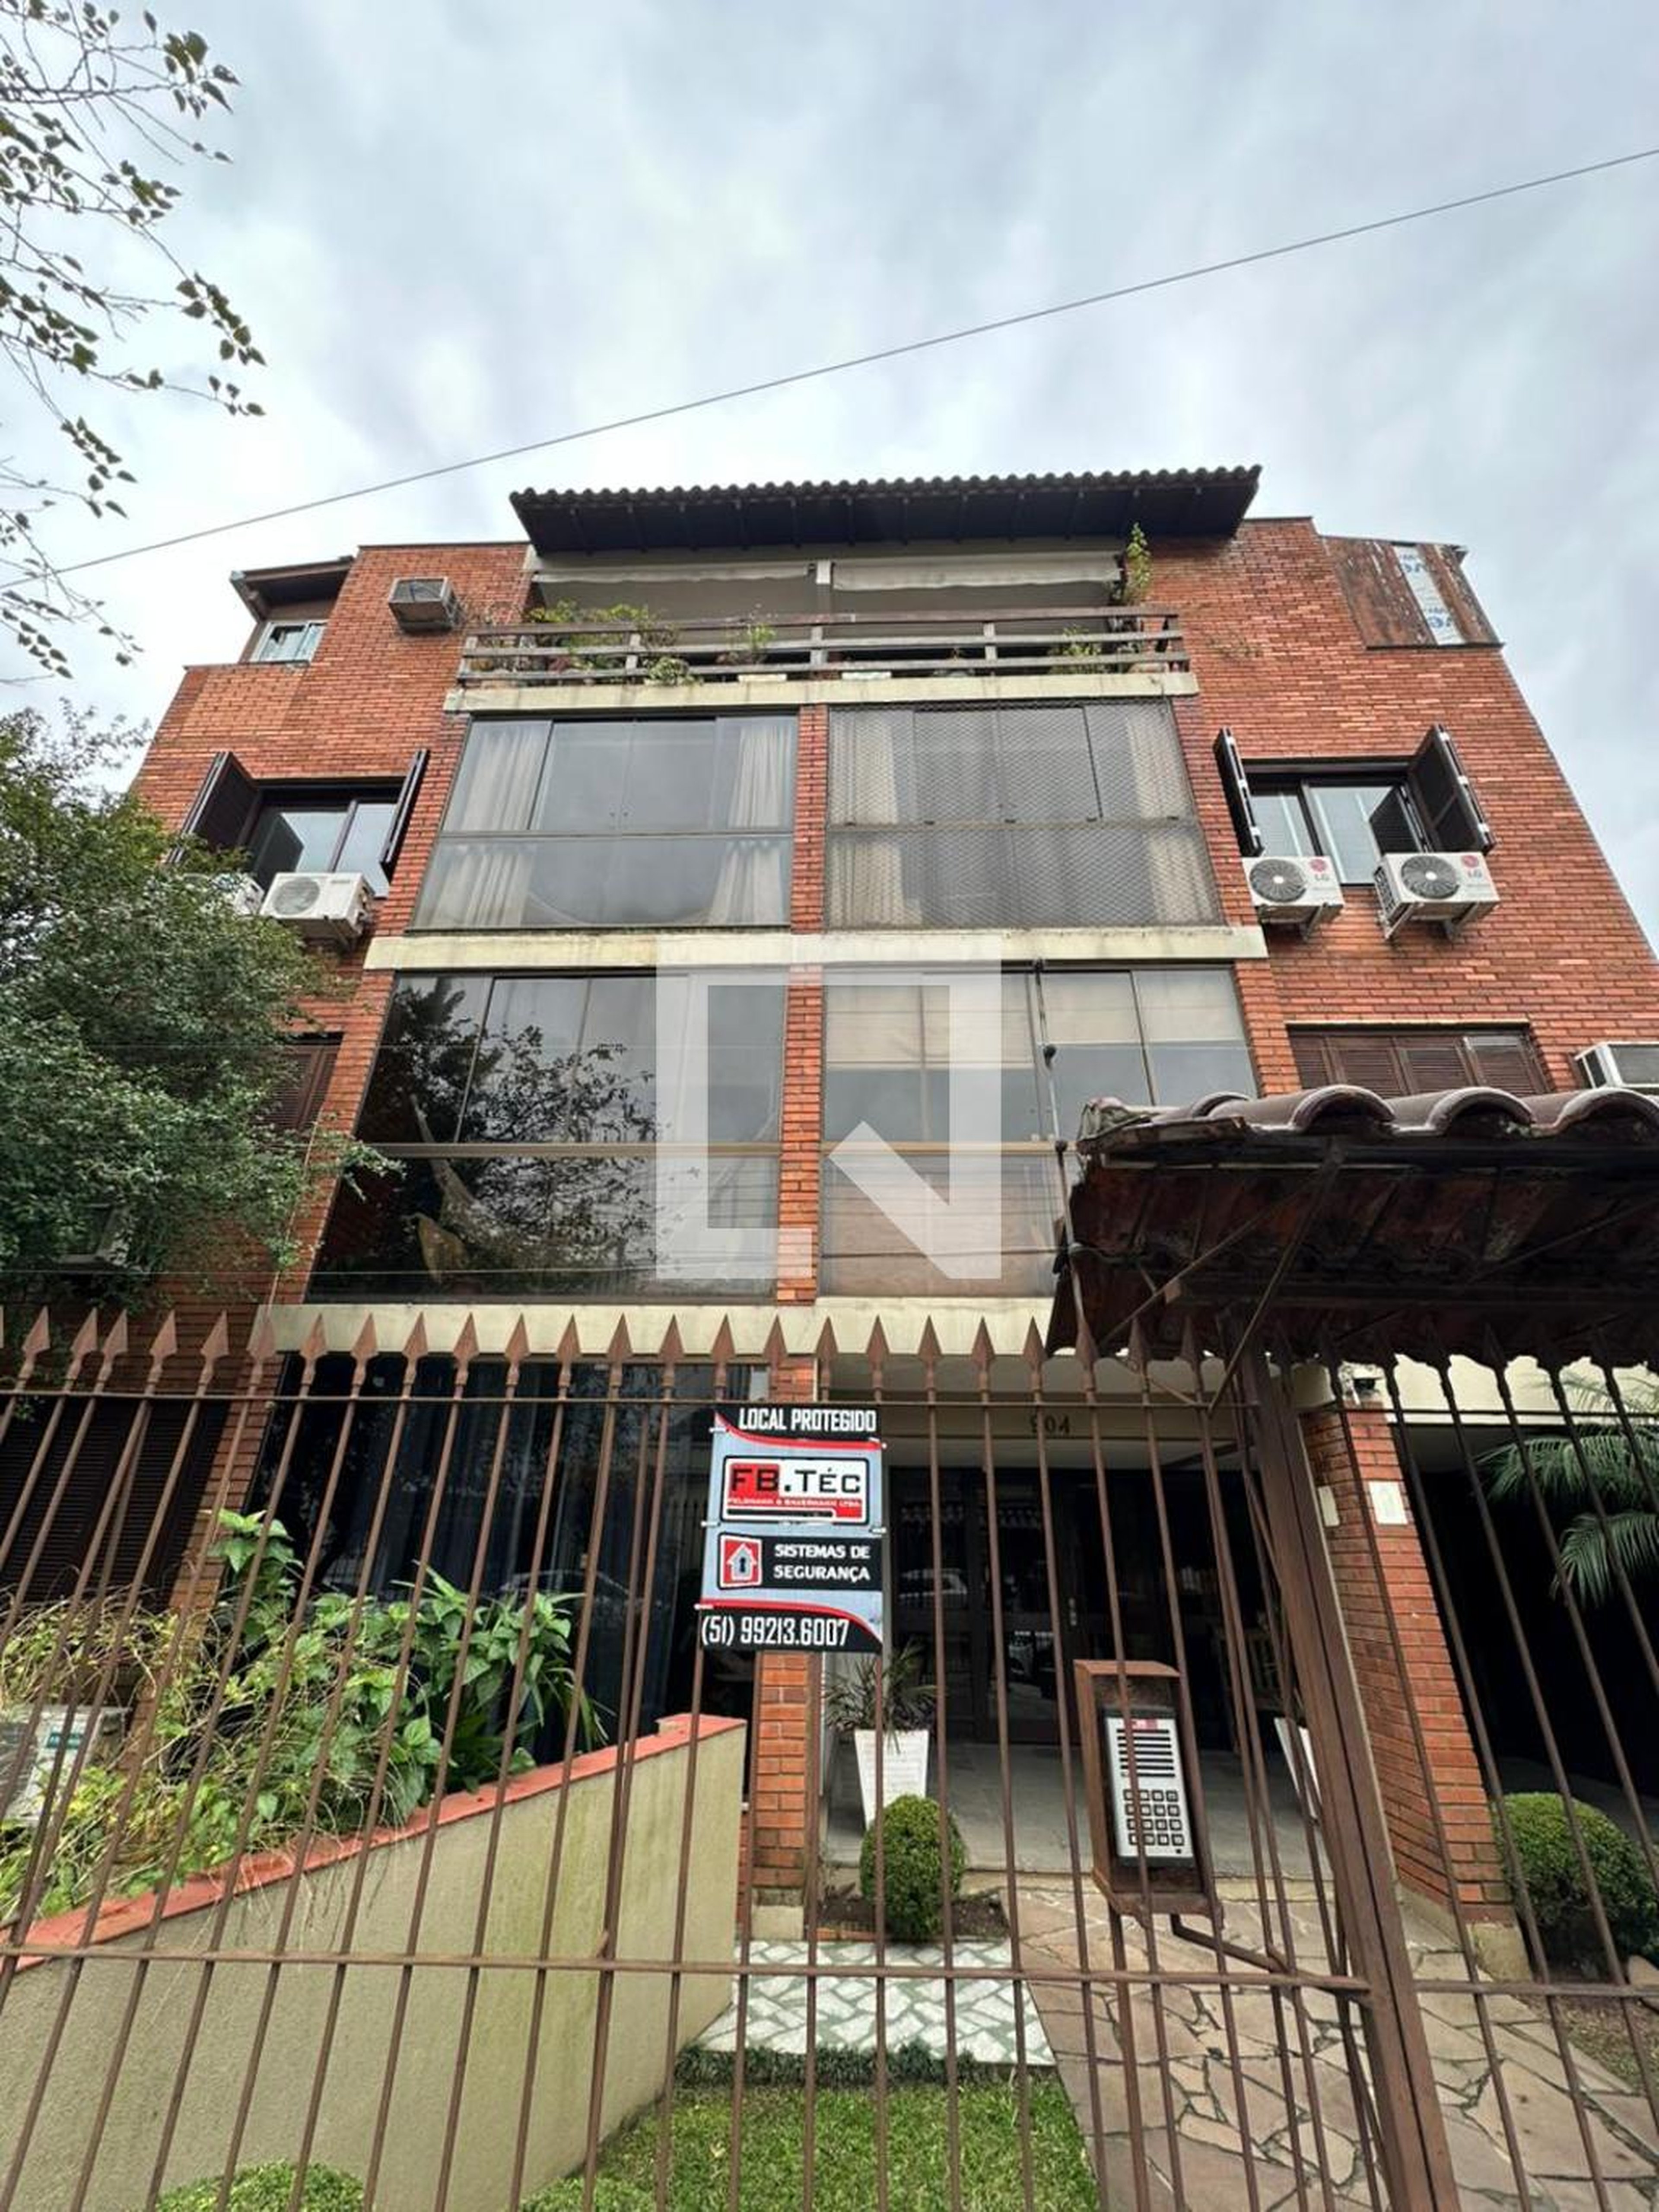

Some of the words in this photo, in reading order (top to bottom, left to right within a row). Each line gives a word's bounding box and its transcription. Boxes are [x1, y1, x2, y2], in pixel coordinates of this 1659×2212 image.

[738, 1407, 787, 1430] LOCAL
[791, 1409, 876, 1432] PROTEGIDO
[774, 1544, 846, 1559] SISTEMAS
[850, 1545, 871, 1559] DE
[773, 1565, 871, 1583] SEGURANÇA
[702, 1615, 734, 1646] (51)
[740, 1617, 850, 1646] 99213.6007
